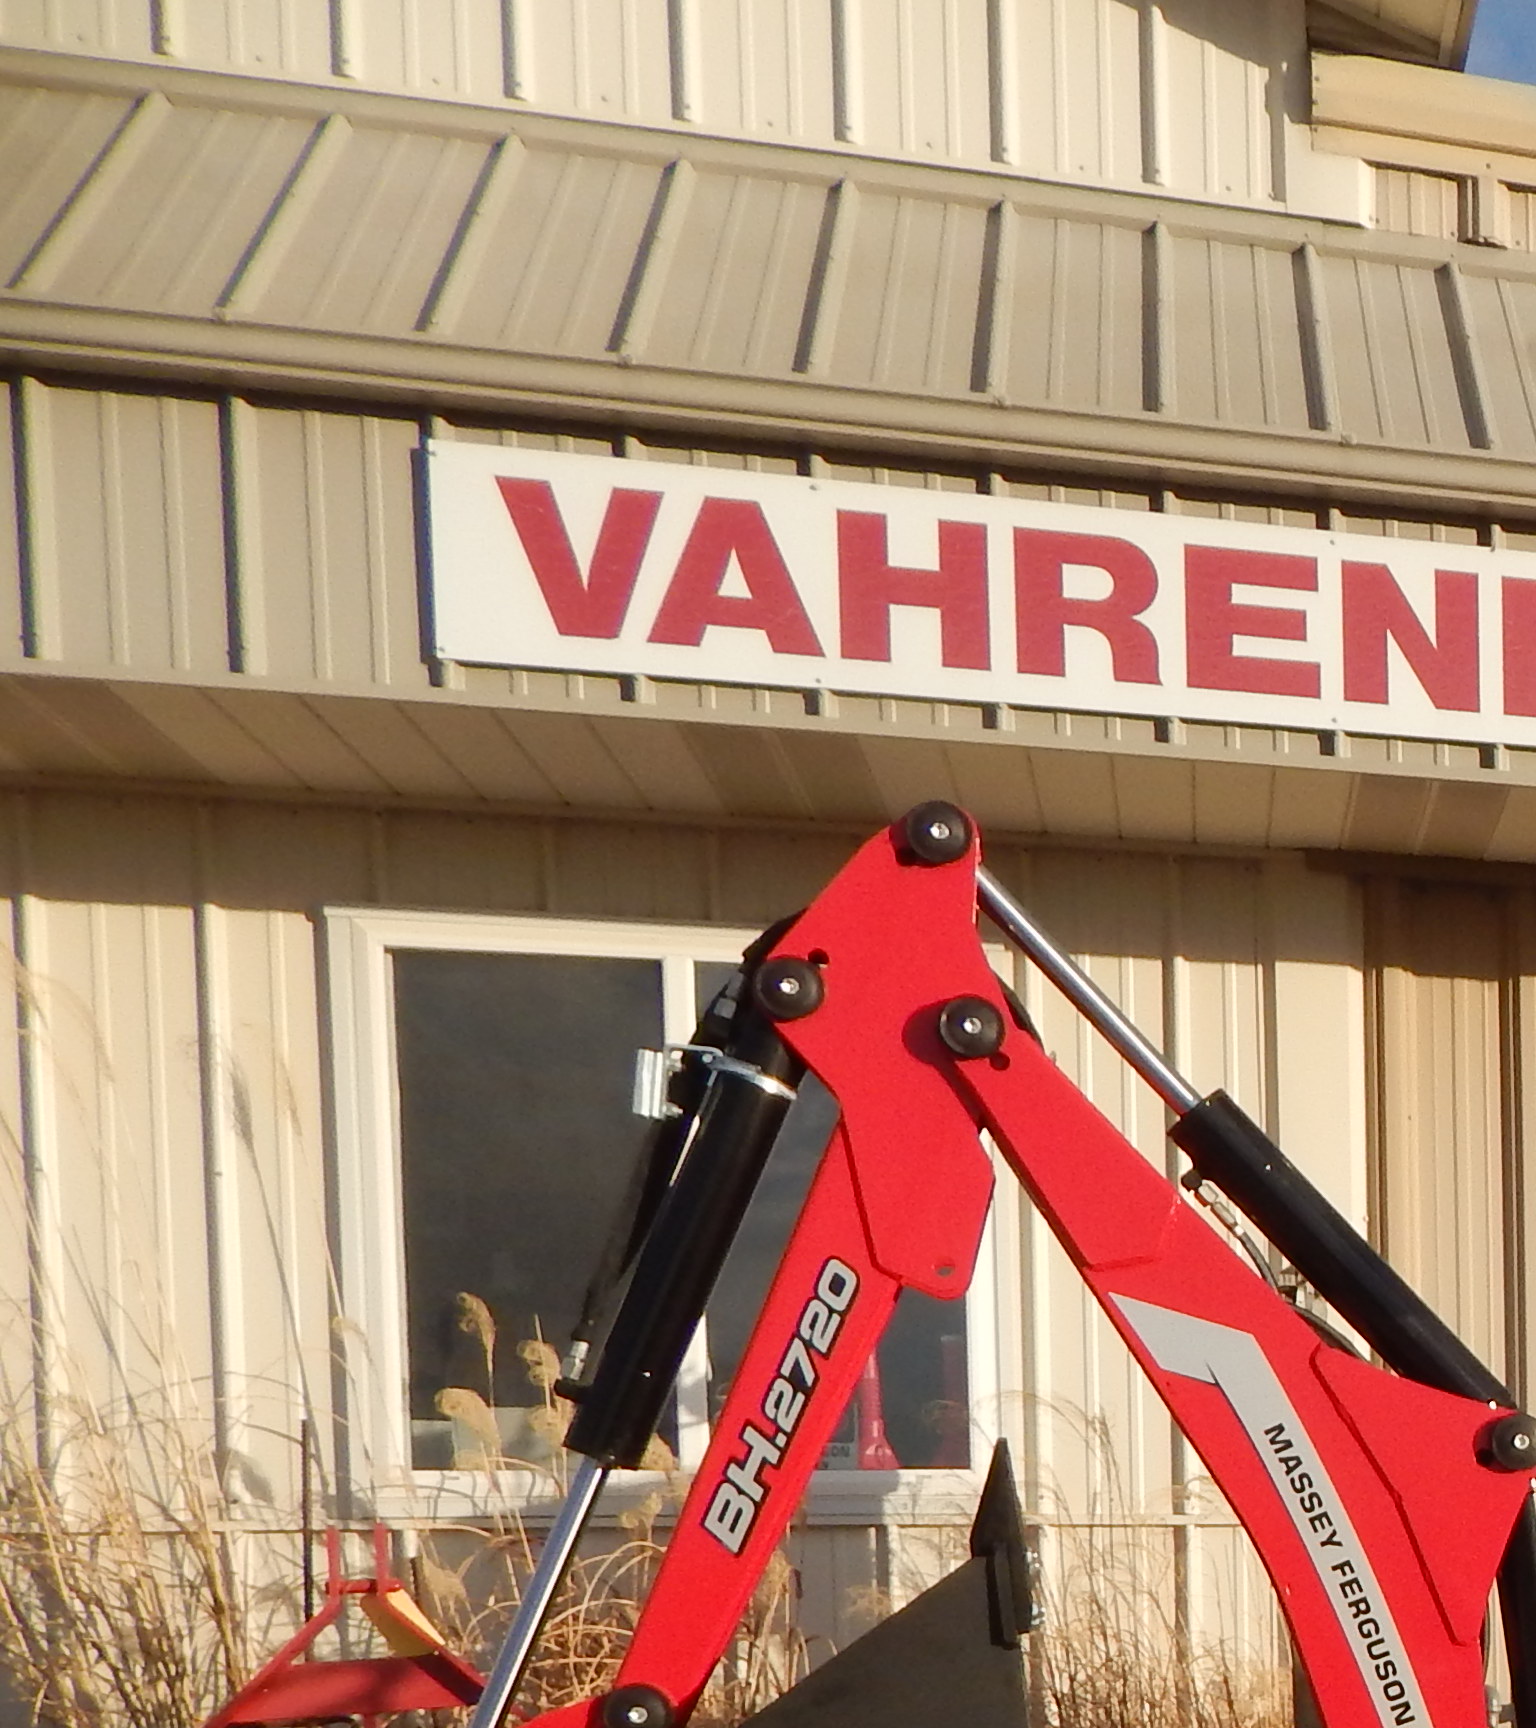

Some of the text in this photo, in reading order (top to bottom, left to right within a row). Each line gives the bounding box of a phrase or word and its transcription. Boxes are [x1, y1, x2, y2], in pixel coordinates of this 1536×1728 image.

[702, 1256, 859, 1555] BH.2720
[1263, 1422, 1417, 1728] MASSEY FERGUSON
